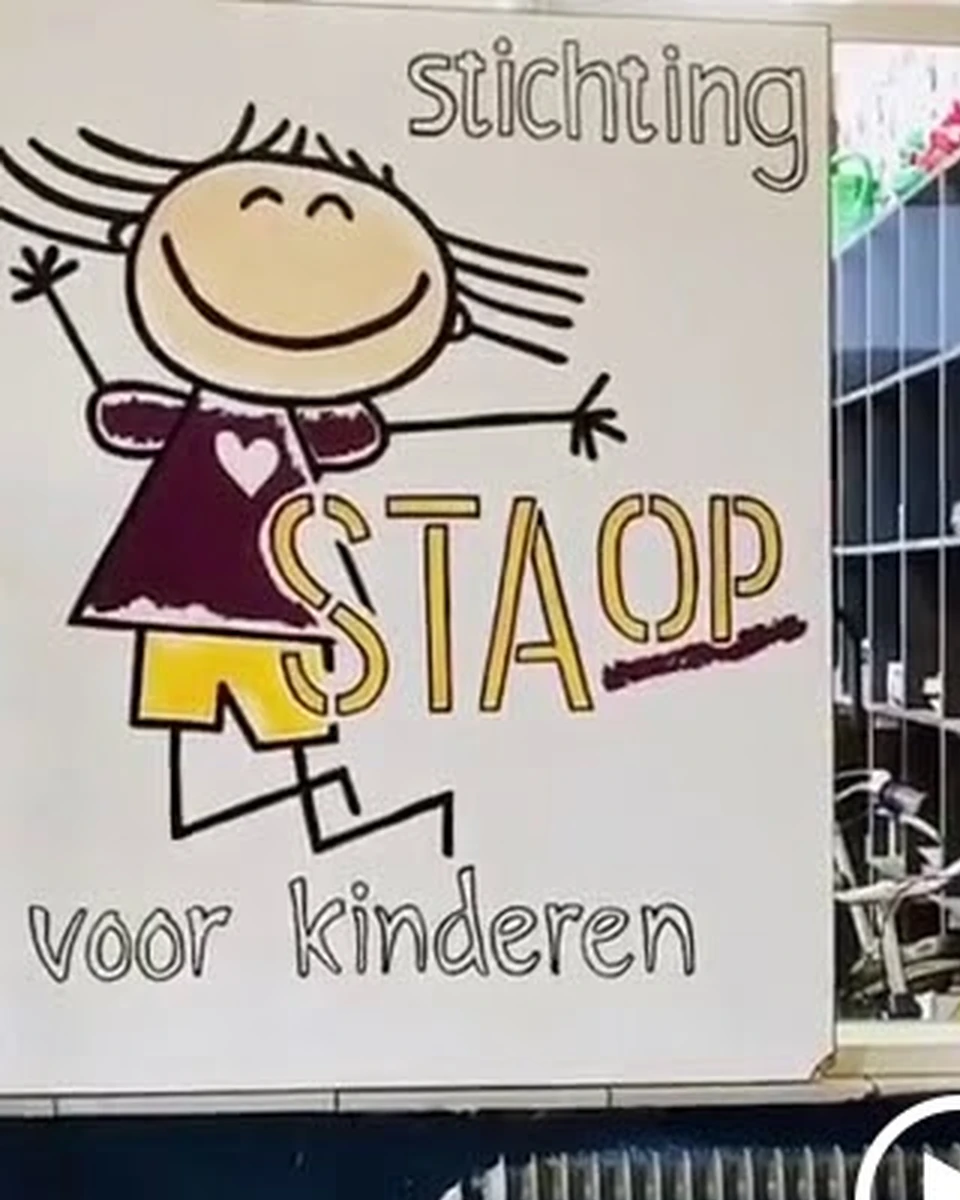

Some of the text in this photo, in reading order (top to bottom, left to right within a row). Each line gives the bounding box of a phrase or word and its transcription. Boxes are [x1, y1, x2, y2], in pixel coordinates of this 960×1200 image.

[409, 38, 807, 192] stichting
[28, 866, 697, 983] voor kinderen
